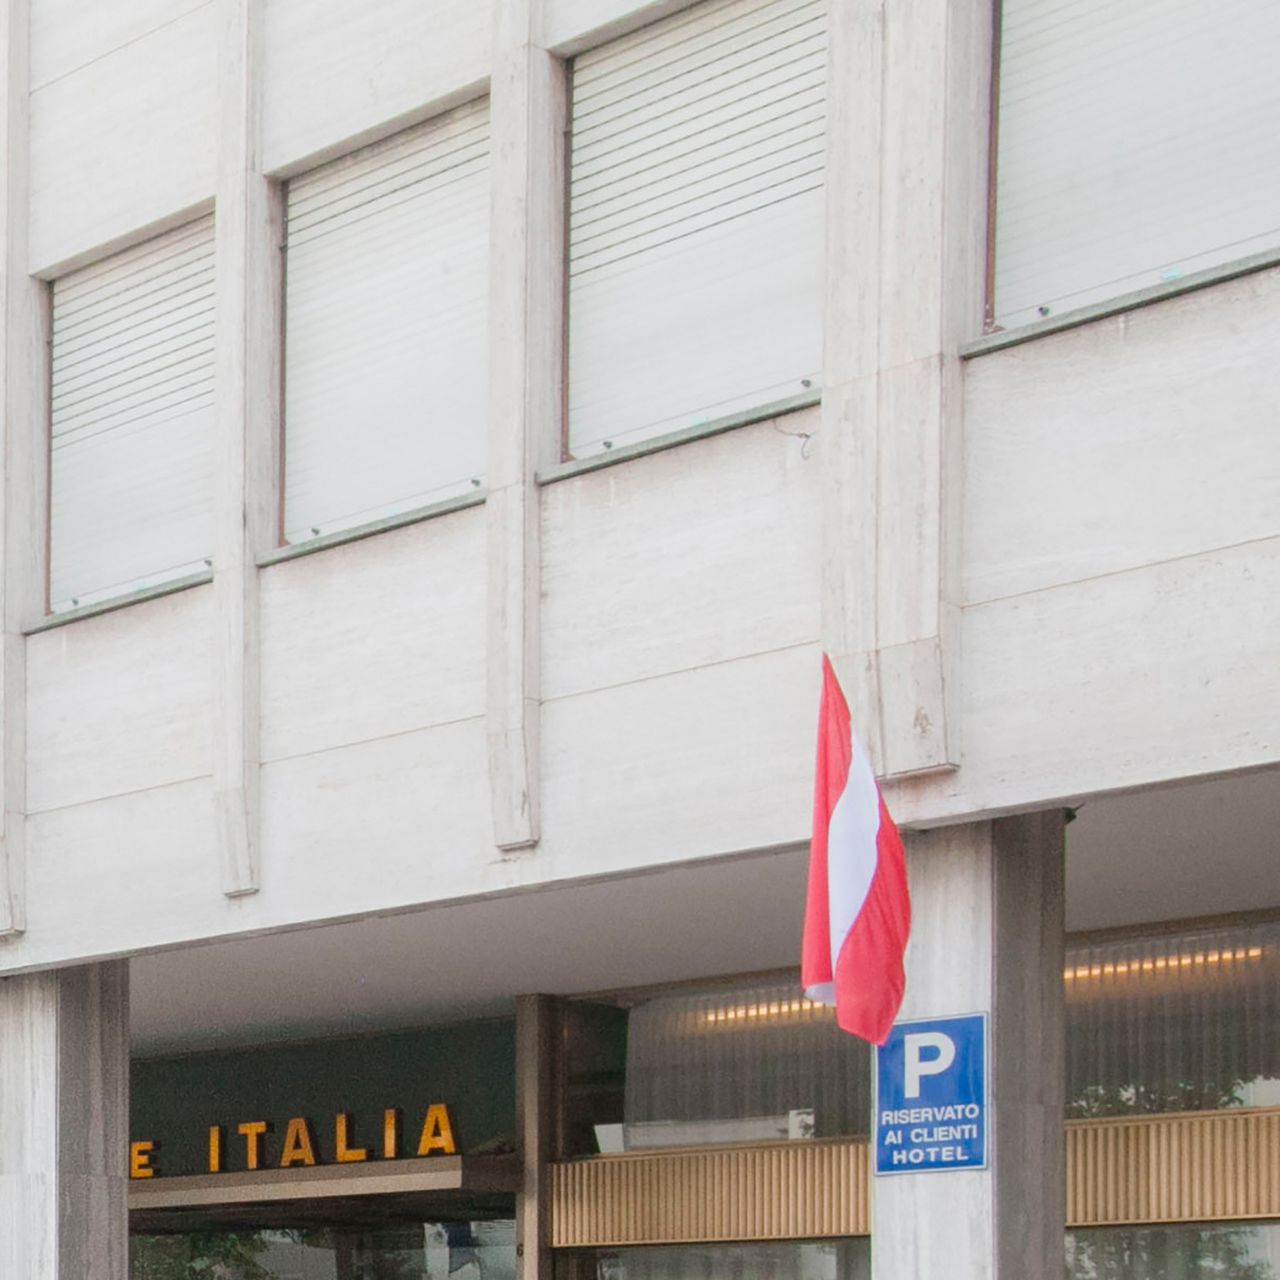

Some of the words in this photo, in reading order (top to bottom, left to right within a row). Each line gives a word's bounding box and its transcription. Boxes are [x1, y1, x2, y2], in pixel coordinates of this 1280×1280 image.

[904, 1032, 956, 1099] P
[881, 1104, 980, 1126] RISERVATO
[209, 1103, 457, 1173] ITALIA
[884, 1130, 902, 1146] AI
[910, 1124, 978, 1144] CLIENTI
[892, 1147, 969, 1165] HOTEL
